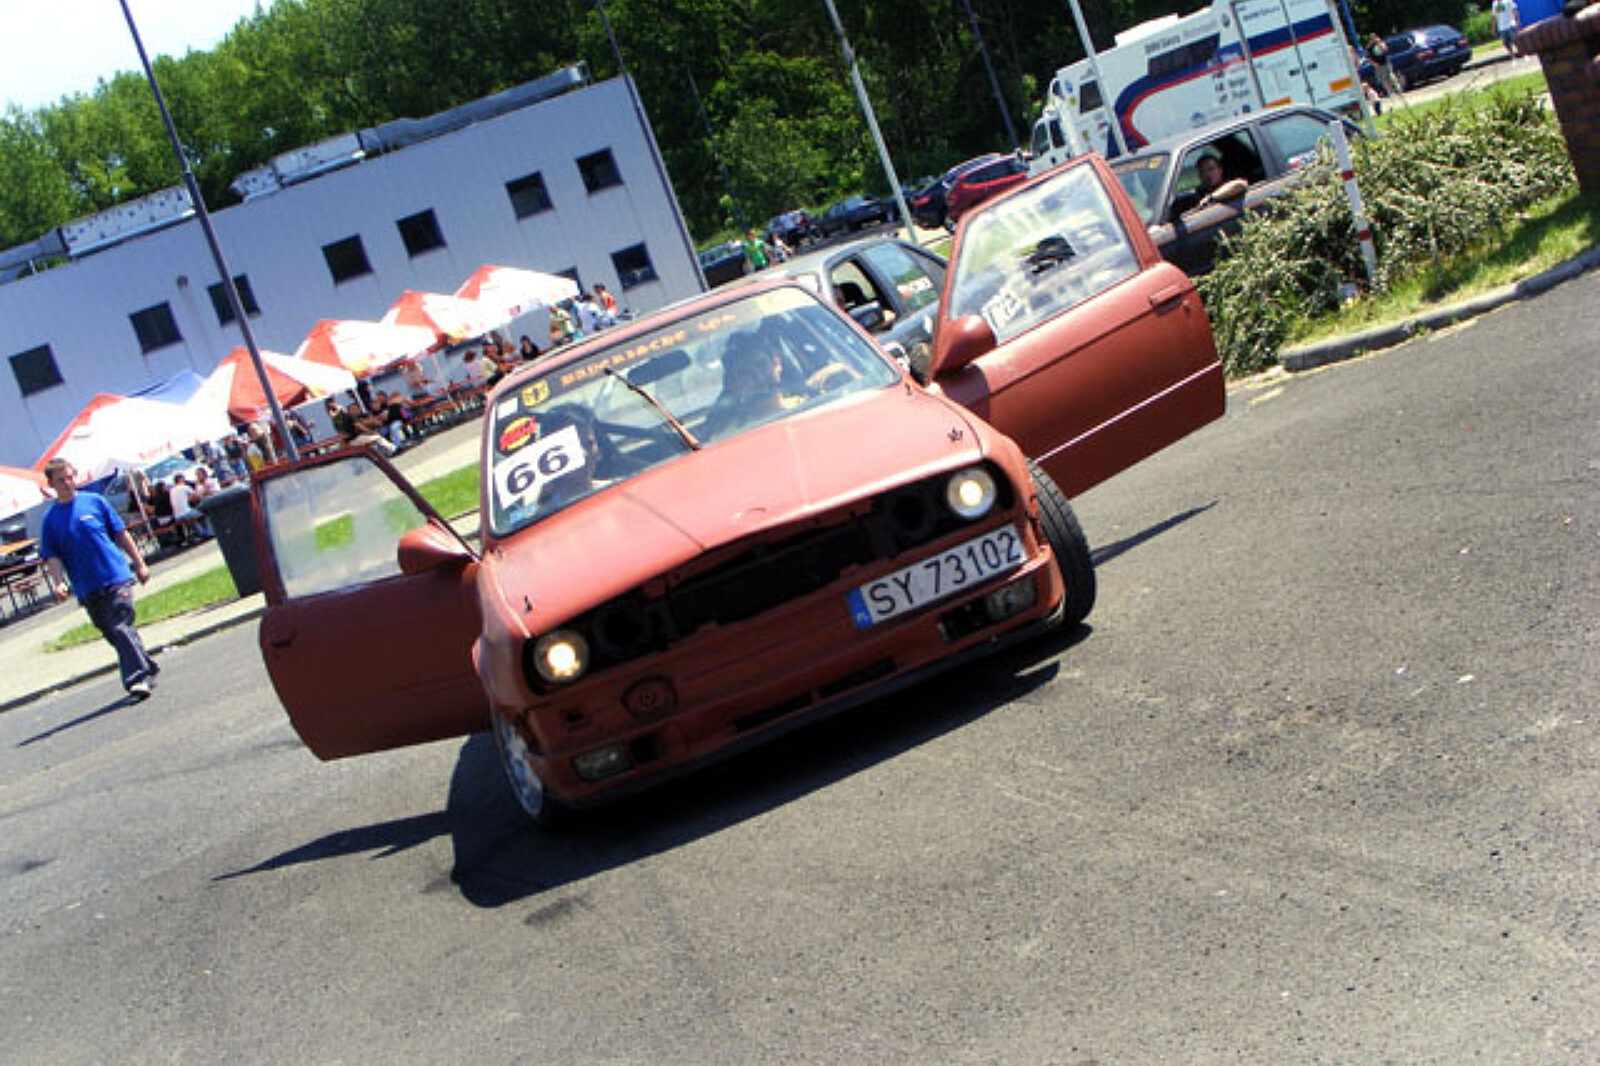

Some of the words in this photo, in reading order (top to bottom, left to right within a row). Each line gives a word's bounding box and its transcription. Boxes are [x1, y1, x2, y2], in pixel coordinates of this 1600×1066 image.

[507, 445, 569, 495] 66
[869, 570, 913, 616] SY
[924, 531, 1020, 594] 73102
